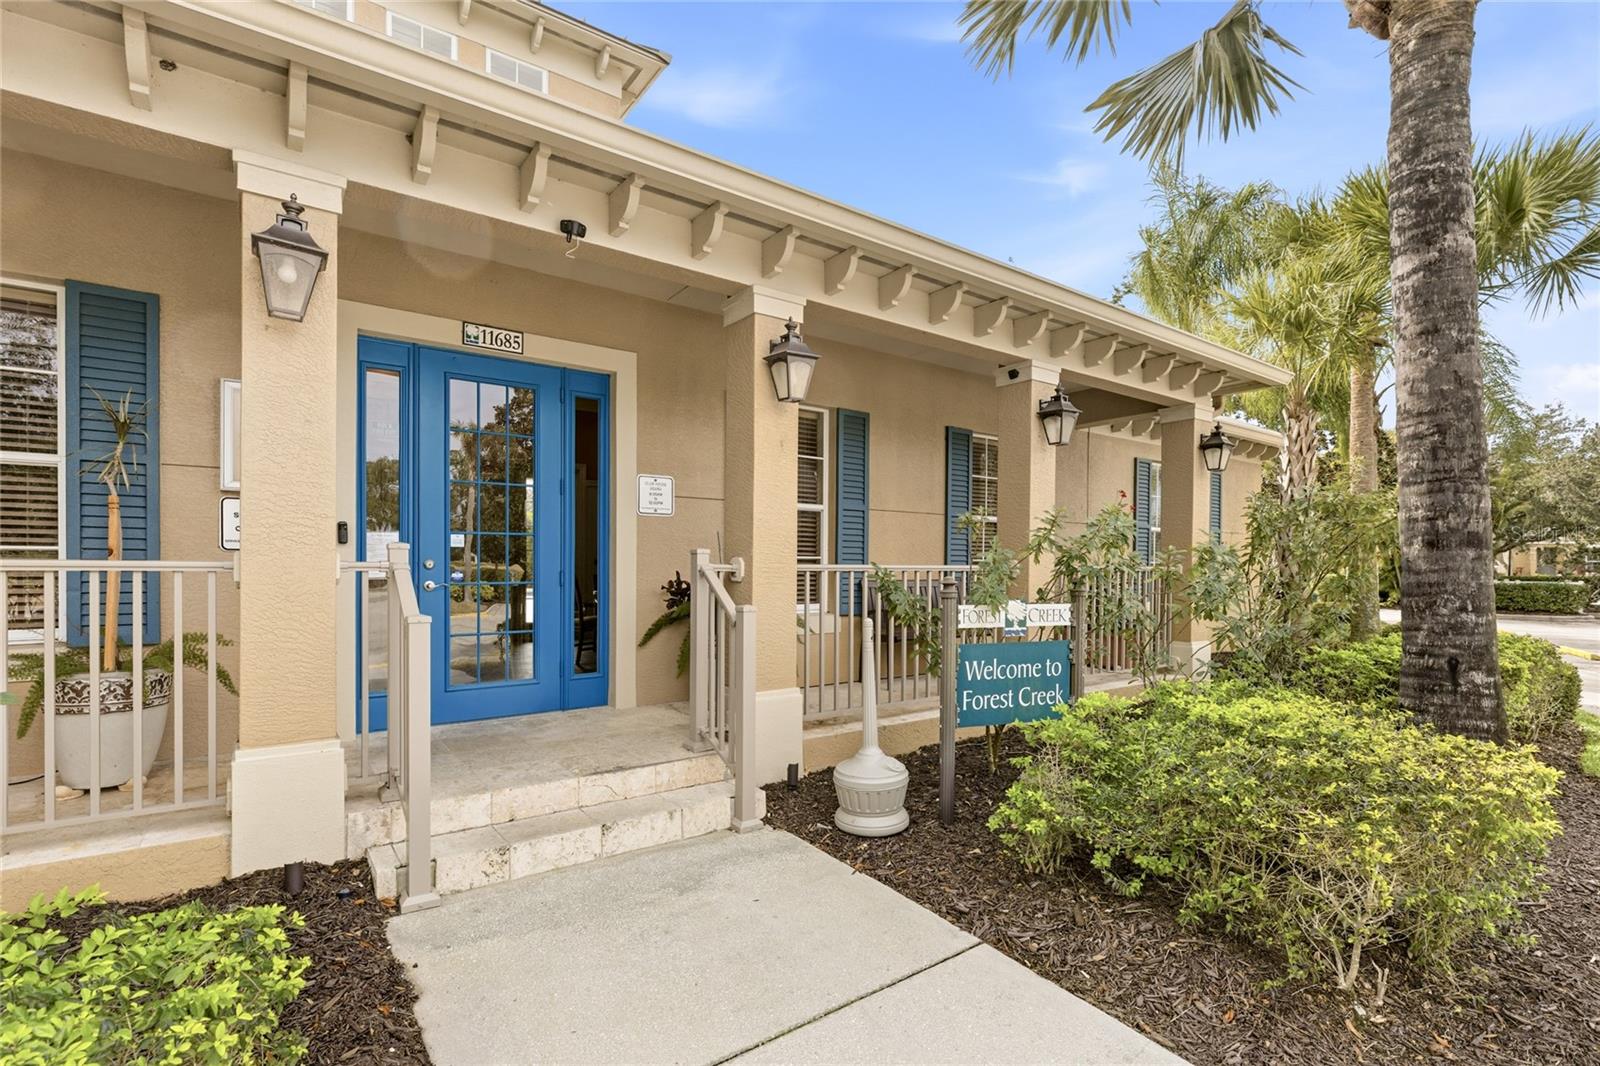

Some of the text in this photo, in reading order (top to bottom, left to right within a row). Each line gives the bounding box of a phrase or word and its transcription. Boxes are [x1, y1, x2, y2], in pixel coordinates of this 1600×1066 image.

[480, 329, 521, 350] 11685
[1028, 607, 1068, 623] CREEK
[965, 658, 1062, 681] Welcome to
[962, 683, 1065, 711] Forest Creek
